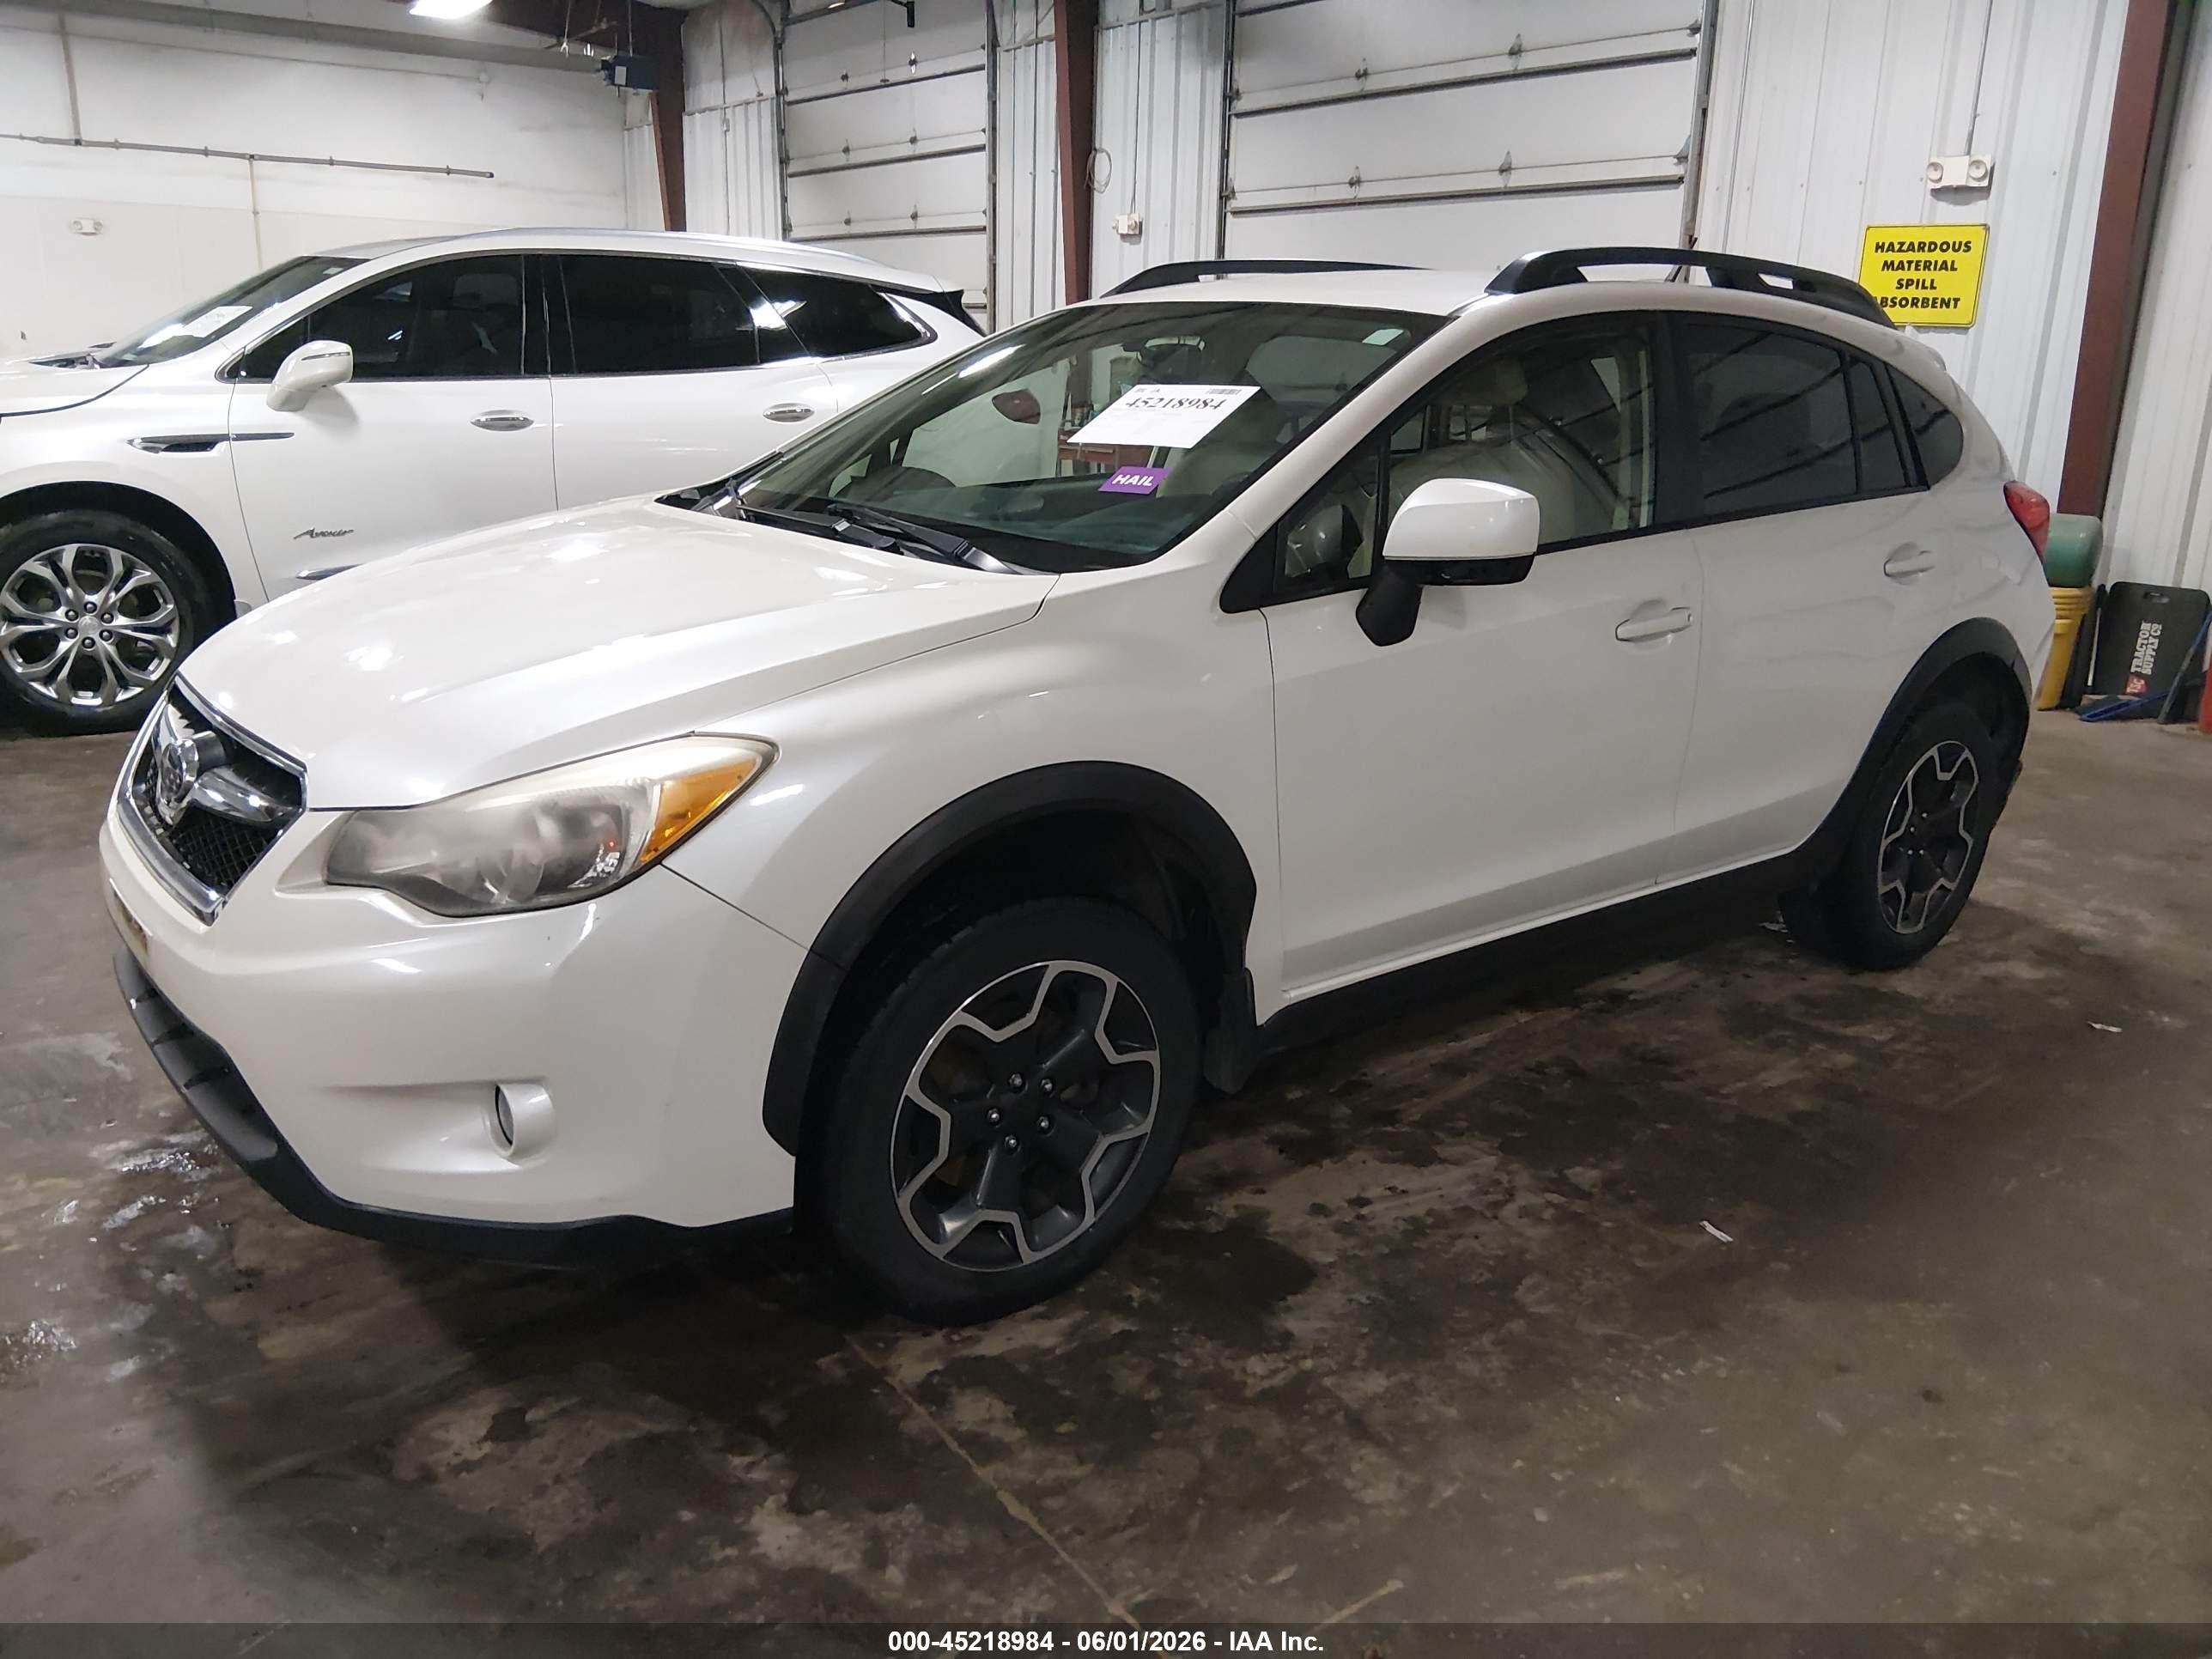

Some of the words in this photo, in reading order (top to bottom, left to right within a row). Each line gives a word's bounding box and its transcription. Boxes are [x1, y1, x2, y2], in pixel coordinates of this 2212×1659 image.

[1875, 240, 1972, 253] HAZARDOUS
[1881, 259, 1958, 272] MATERIAL
[1895, 278, 1937, 290] SPILL
[1126, 397, 1227, 410] 45218984
[1112, 474, 1154, 487] HAIL
[2130, 622, 2152, 673] TRACTOR
[2142, 637, 2160, 676] SUPPLY
